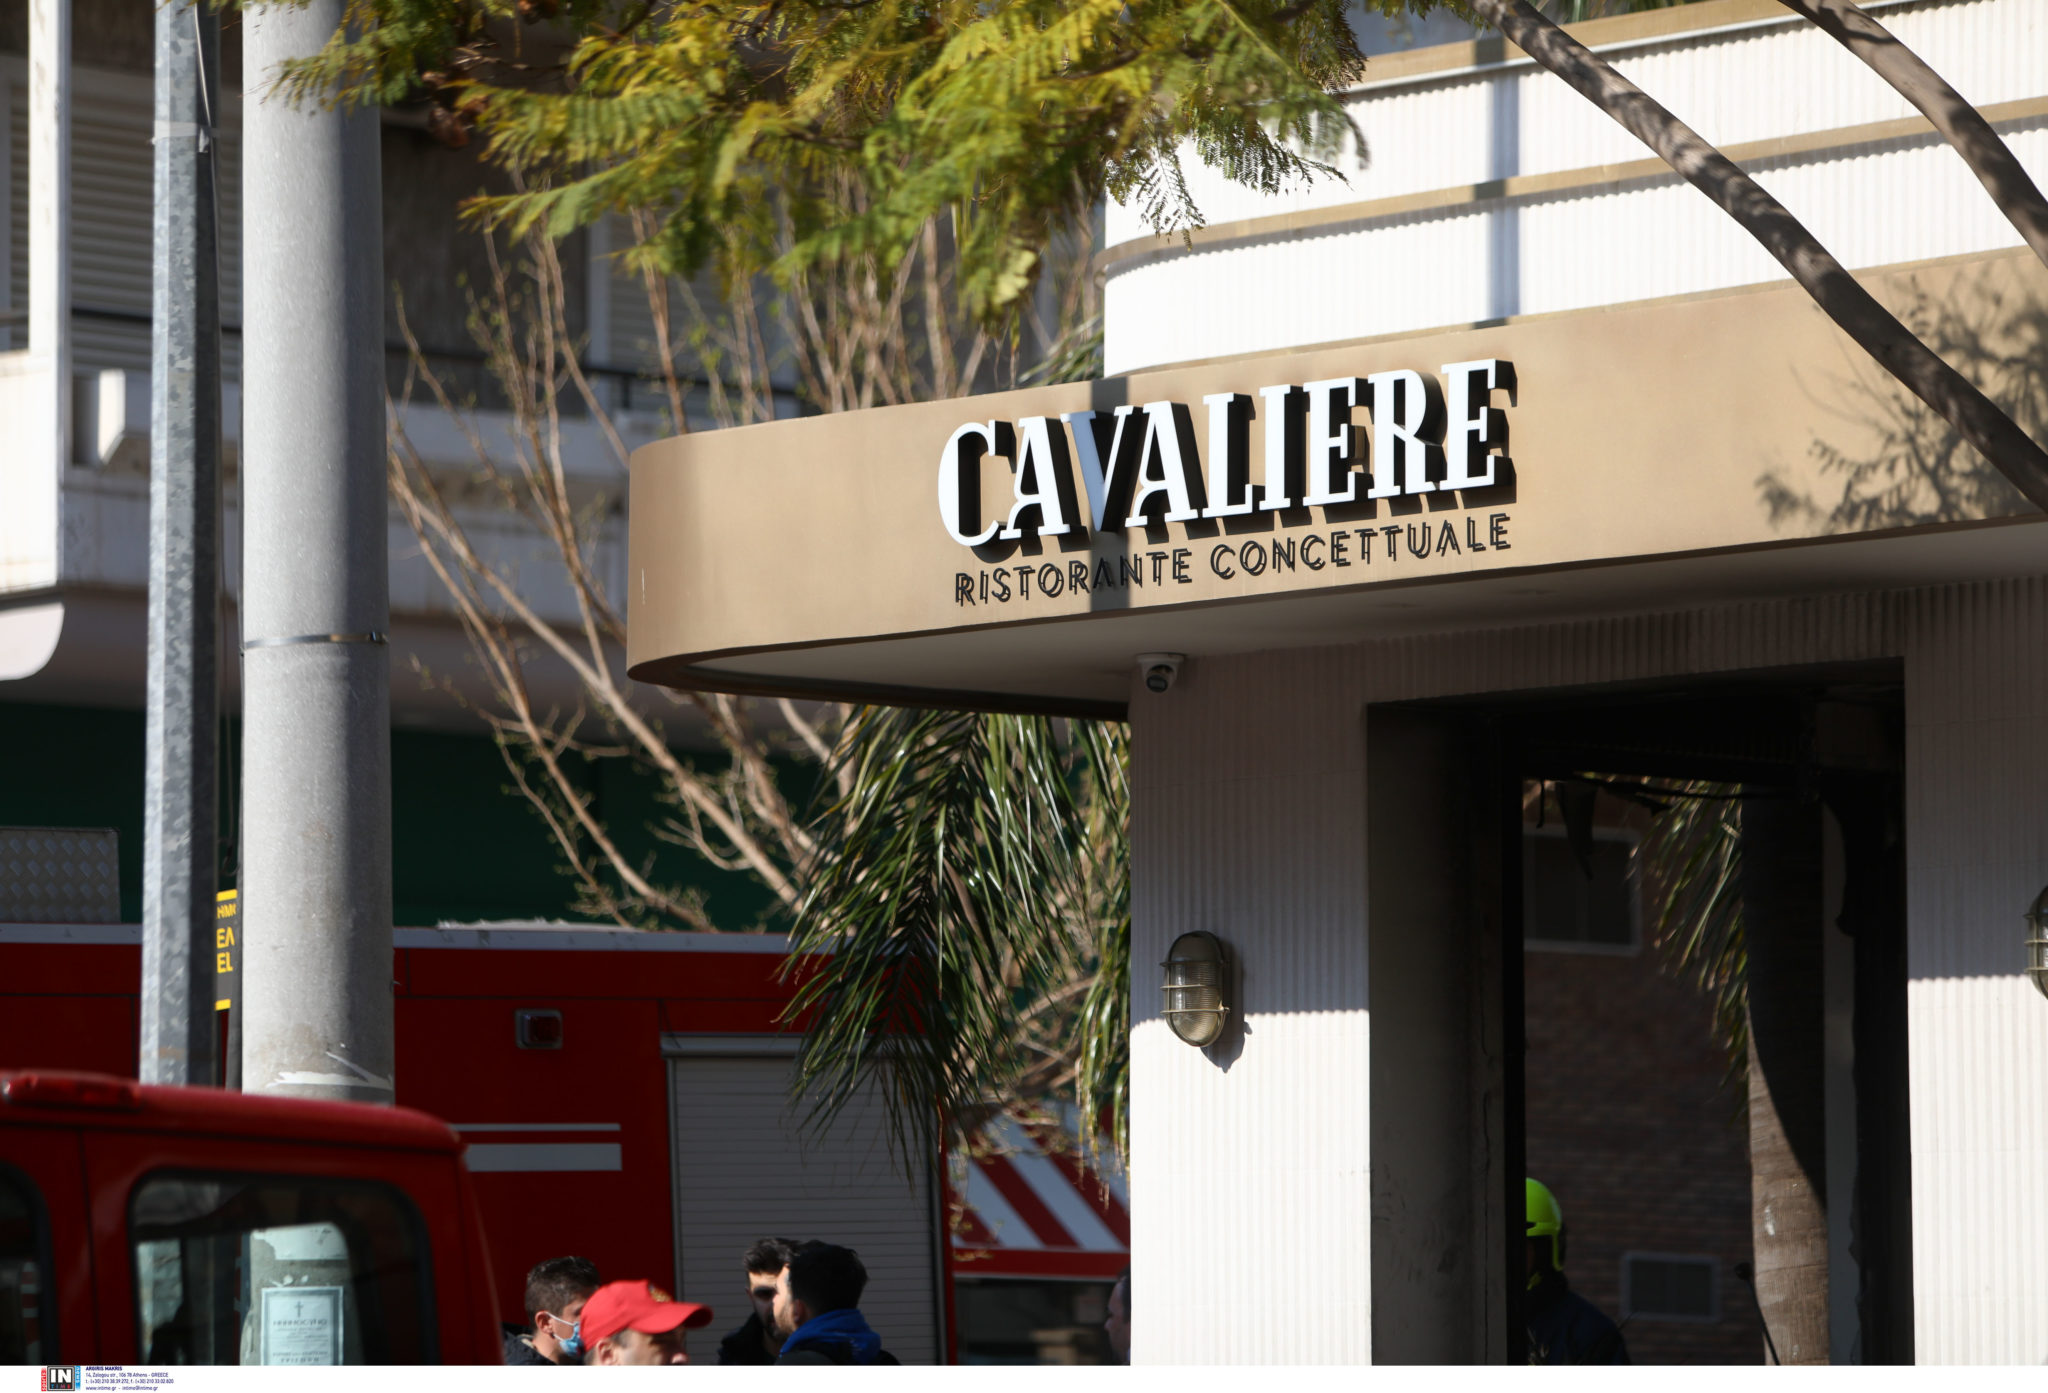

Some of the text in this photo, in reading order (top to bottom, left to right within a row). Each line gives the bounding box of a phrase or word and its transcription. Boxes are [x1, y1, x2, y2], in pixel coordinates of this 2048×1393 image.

[938, 358, 1502, 548] CAVALIERE
[955, 512, 1512, 607] RISTORANTE CONCETTUALE
